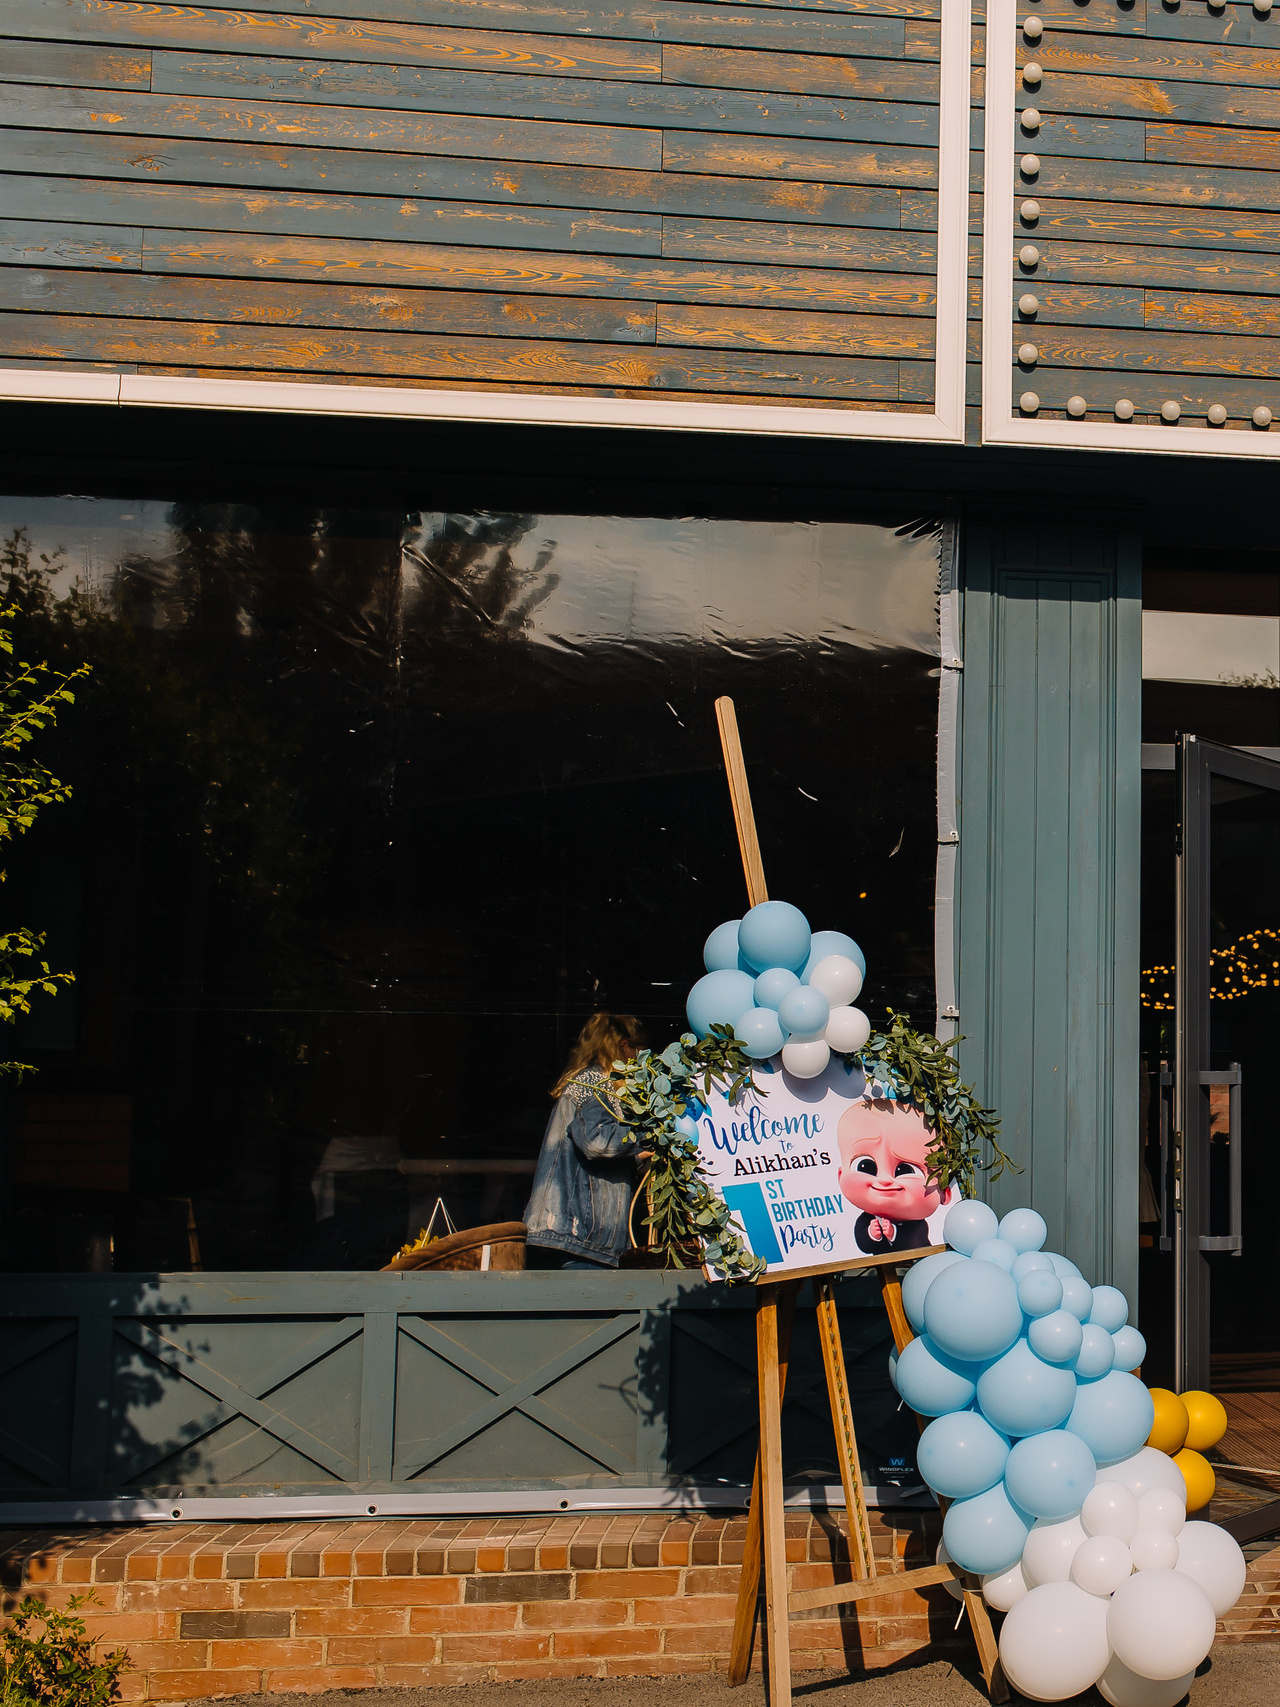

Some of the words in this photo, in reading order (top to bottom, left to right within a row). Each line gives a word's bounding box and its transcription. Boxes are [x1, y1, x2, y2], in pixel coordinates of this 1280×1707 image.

[703, 1105, 826, 1156] Welcome
[778, 1138, 796, 1154] to
[733, 1148, 832, 1177] Alikhan's
[721, 1181, 785, 1265] 1
[764, 1178, 786, 1200] ST
[770, 1193, 845, 1223] BIRTHDAY
[778, 1222, 837, 1255] Party
